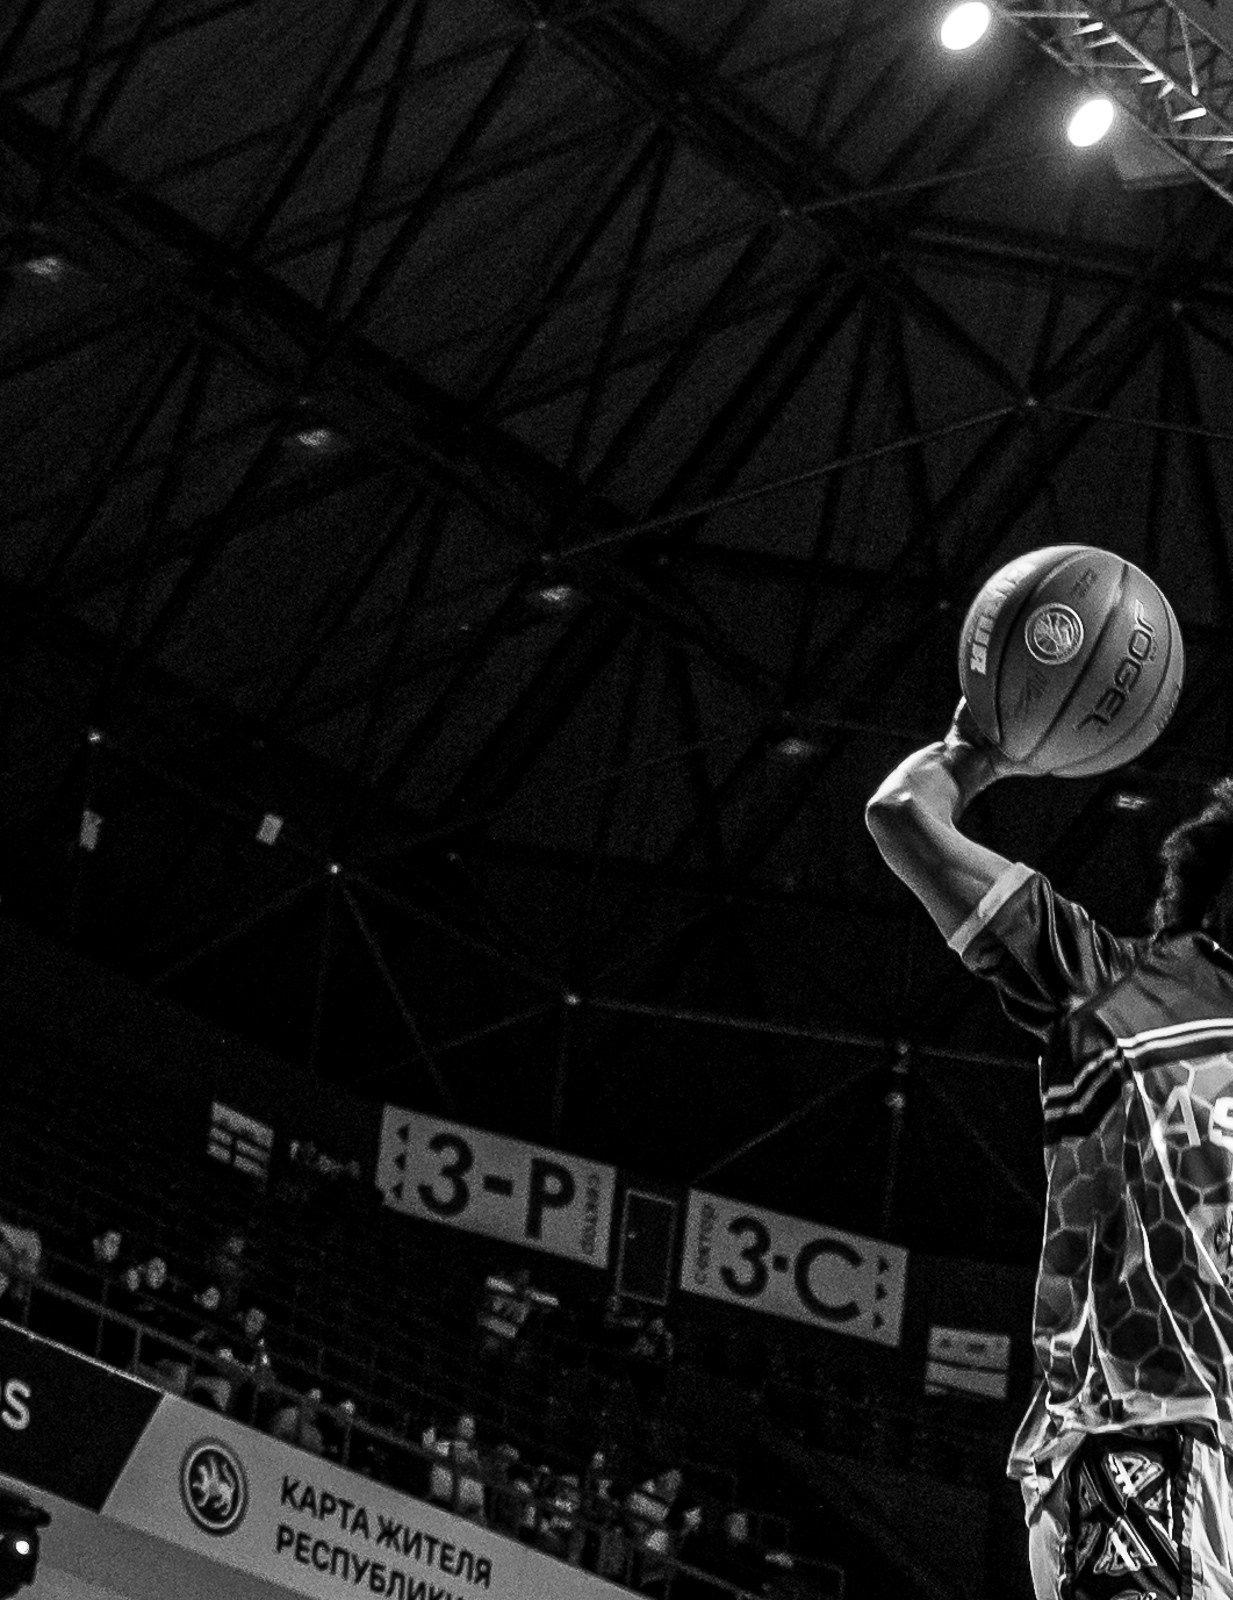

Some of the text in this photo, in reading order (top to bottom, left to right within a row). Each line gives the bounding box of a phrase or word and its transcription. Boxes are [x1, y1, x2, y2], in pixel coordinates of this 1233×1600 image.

[1, 1379, 31, 1431] S
[281, 1475, 493, 1590] КАРТА ЖИТЕЛЯ
